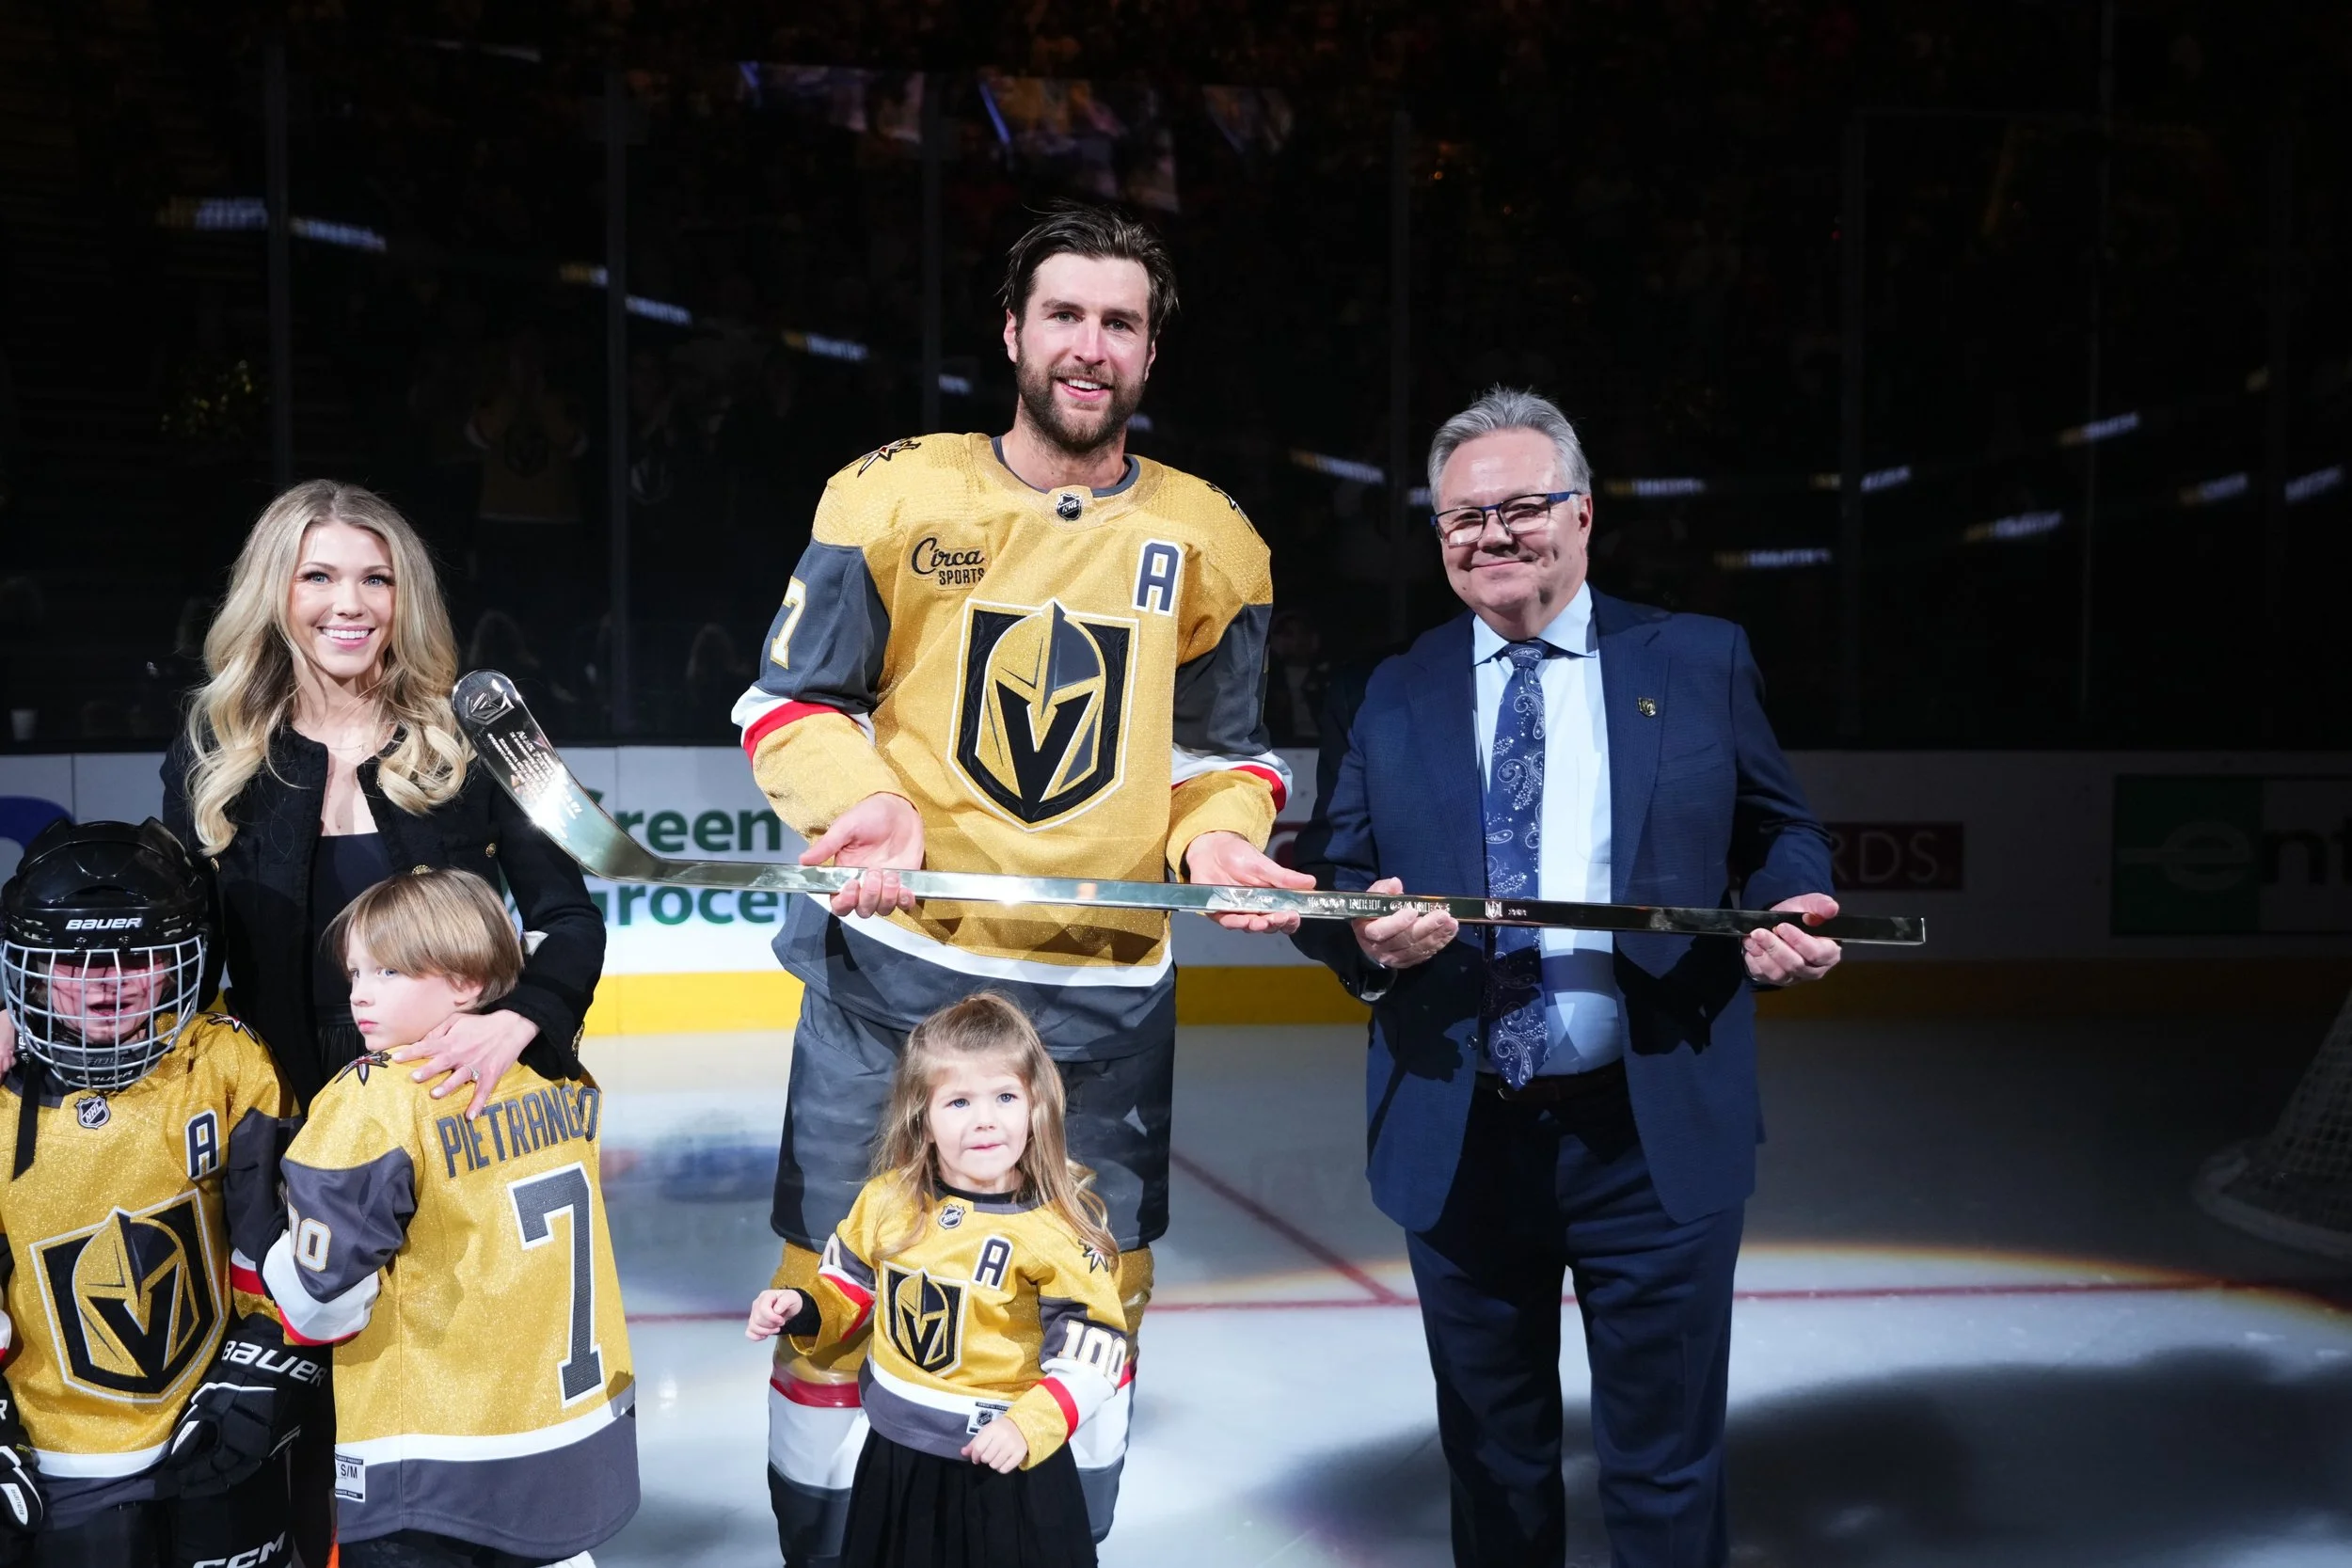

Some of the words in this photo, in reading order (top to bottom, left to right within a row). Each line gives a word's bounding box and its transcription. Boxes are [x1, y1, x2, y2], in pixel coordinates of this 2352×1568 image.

[911, 536, 986, 576] Circa
[938, 567, 986, 586] SPORTS
[1131, 538, 1185, 617] A
[769, 577, 807, 670] 7
[582, 788, 782, 852] reen
[583, 873, 791, 926] roce
[184, 1108, 221, 1181] A
[506, 1161, 605, 1410] 7
[970, 1234, 1014, 1291] A
[1057, 1319, 1128, 1389] 100
[340, 1463, 358, 1480] S/M
